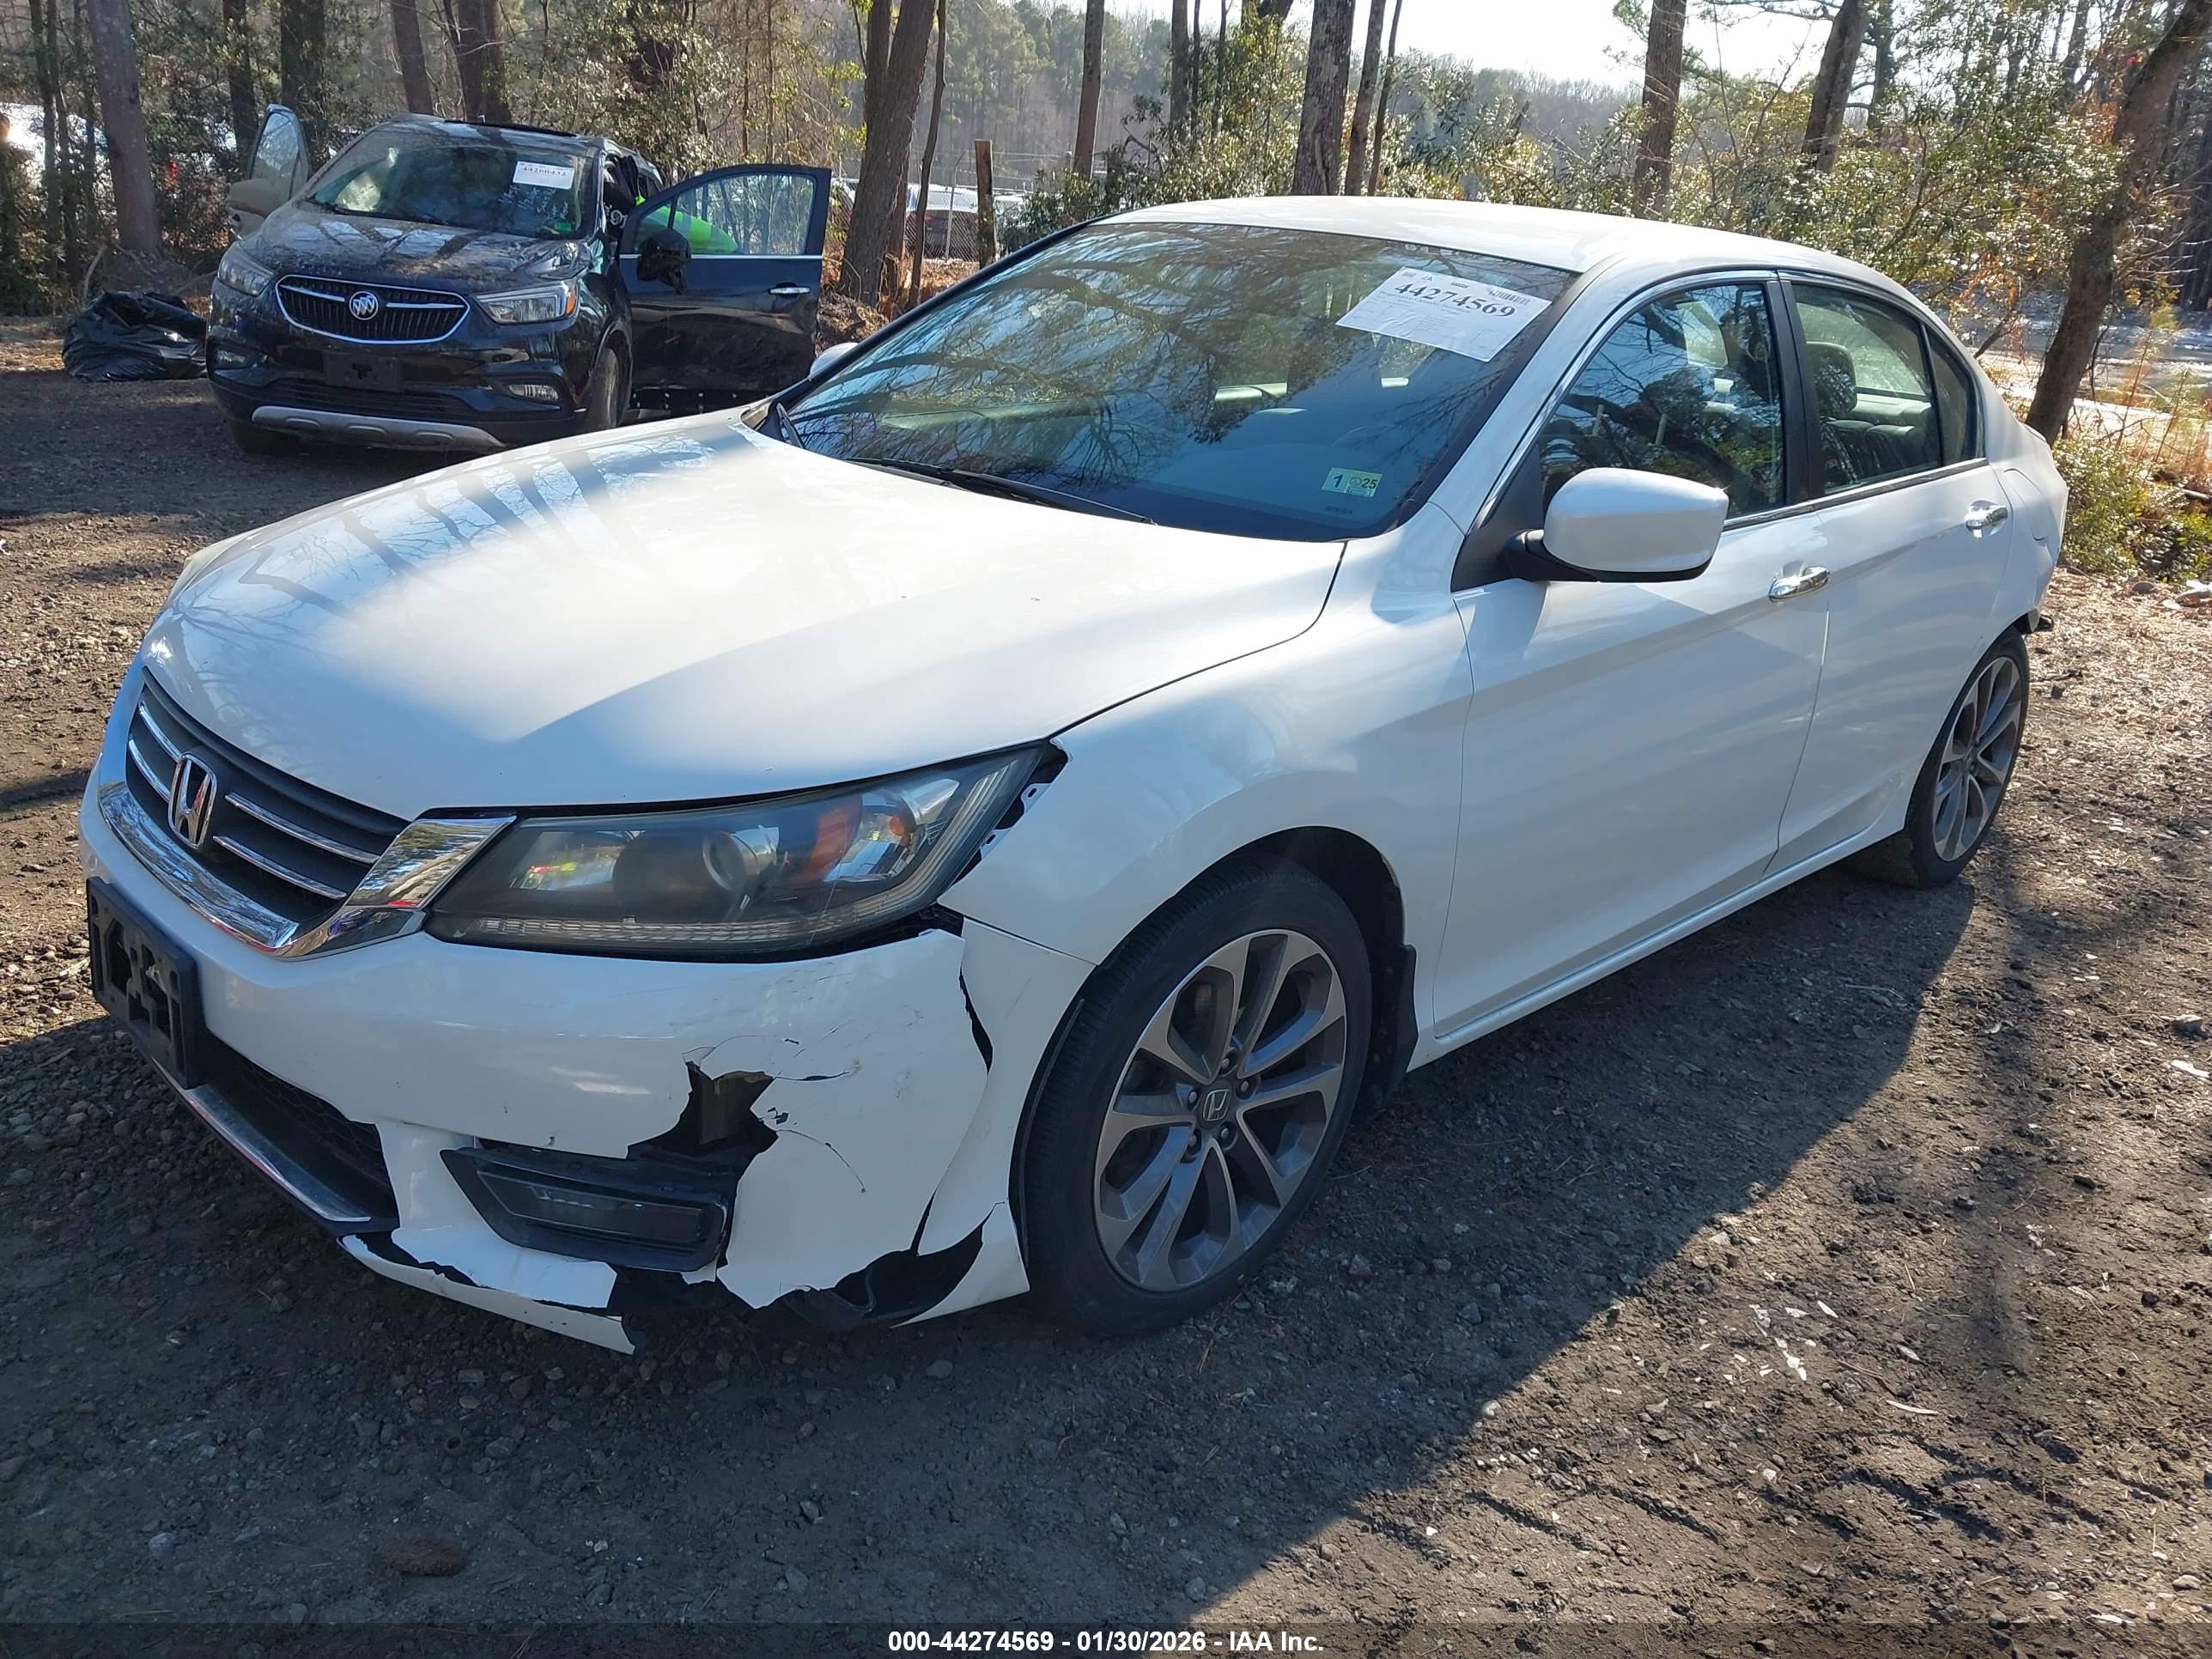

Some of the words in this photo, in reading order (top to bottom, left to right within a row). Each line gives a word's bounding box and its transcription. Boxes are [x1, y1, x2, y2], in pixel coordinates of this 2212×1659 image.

[1394, 283, 1516, 317] 44274569
[1333, 474, 1344, 489] 1
[1361, 477, 1378, 489] 25
